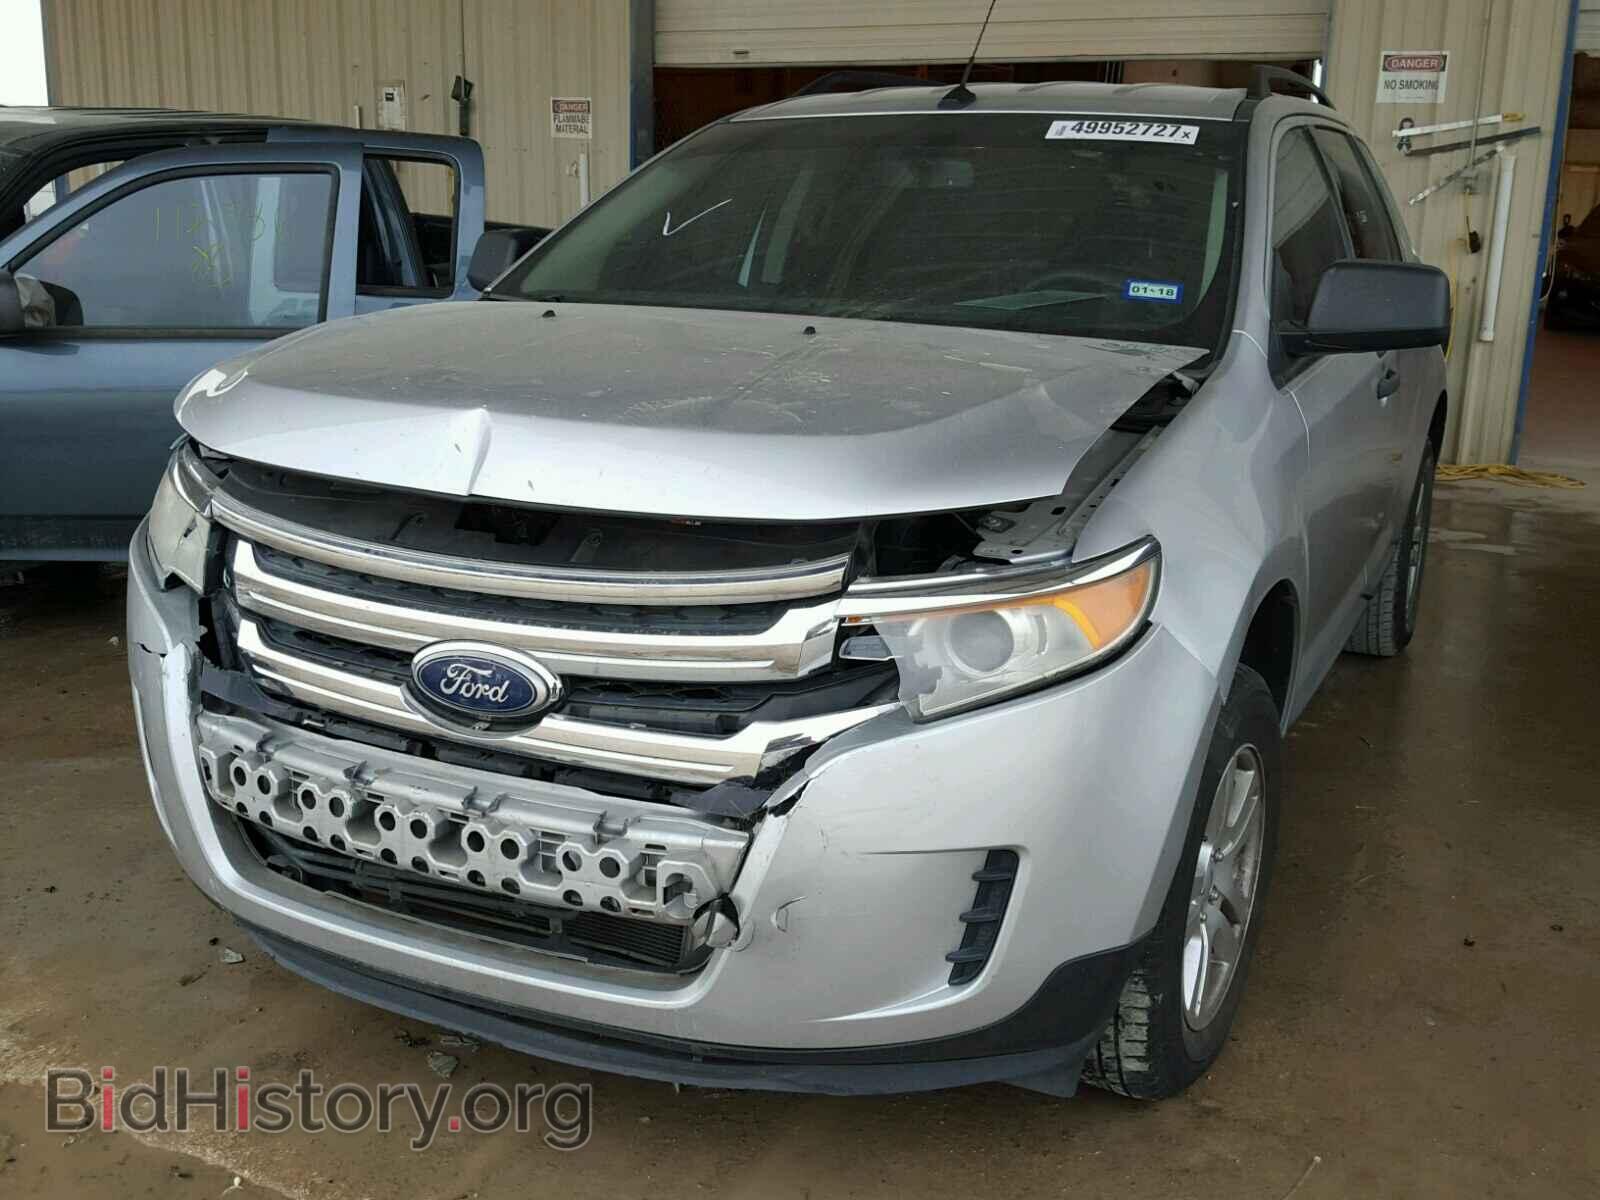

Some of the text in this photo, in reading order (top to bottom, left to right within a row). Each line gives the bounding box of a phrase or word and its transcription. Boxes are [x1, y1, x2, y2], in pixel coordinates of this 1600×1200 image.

[1391, 58, 1438, 69] DANGER
[1383, 79, 1439, 90] NO SMOKING
[1131, 285, 1175, 297] 01-18
[440, 663, 511, 703] Ford
